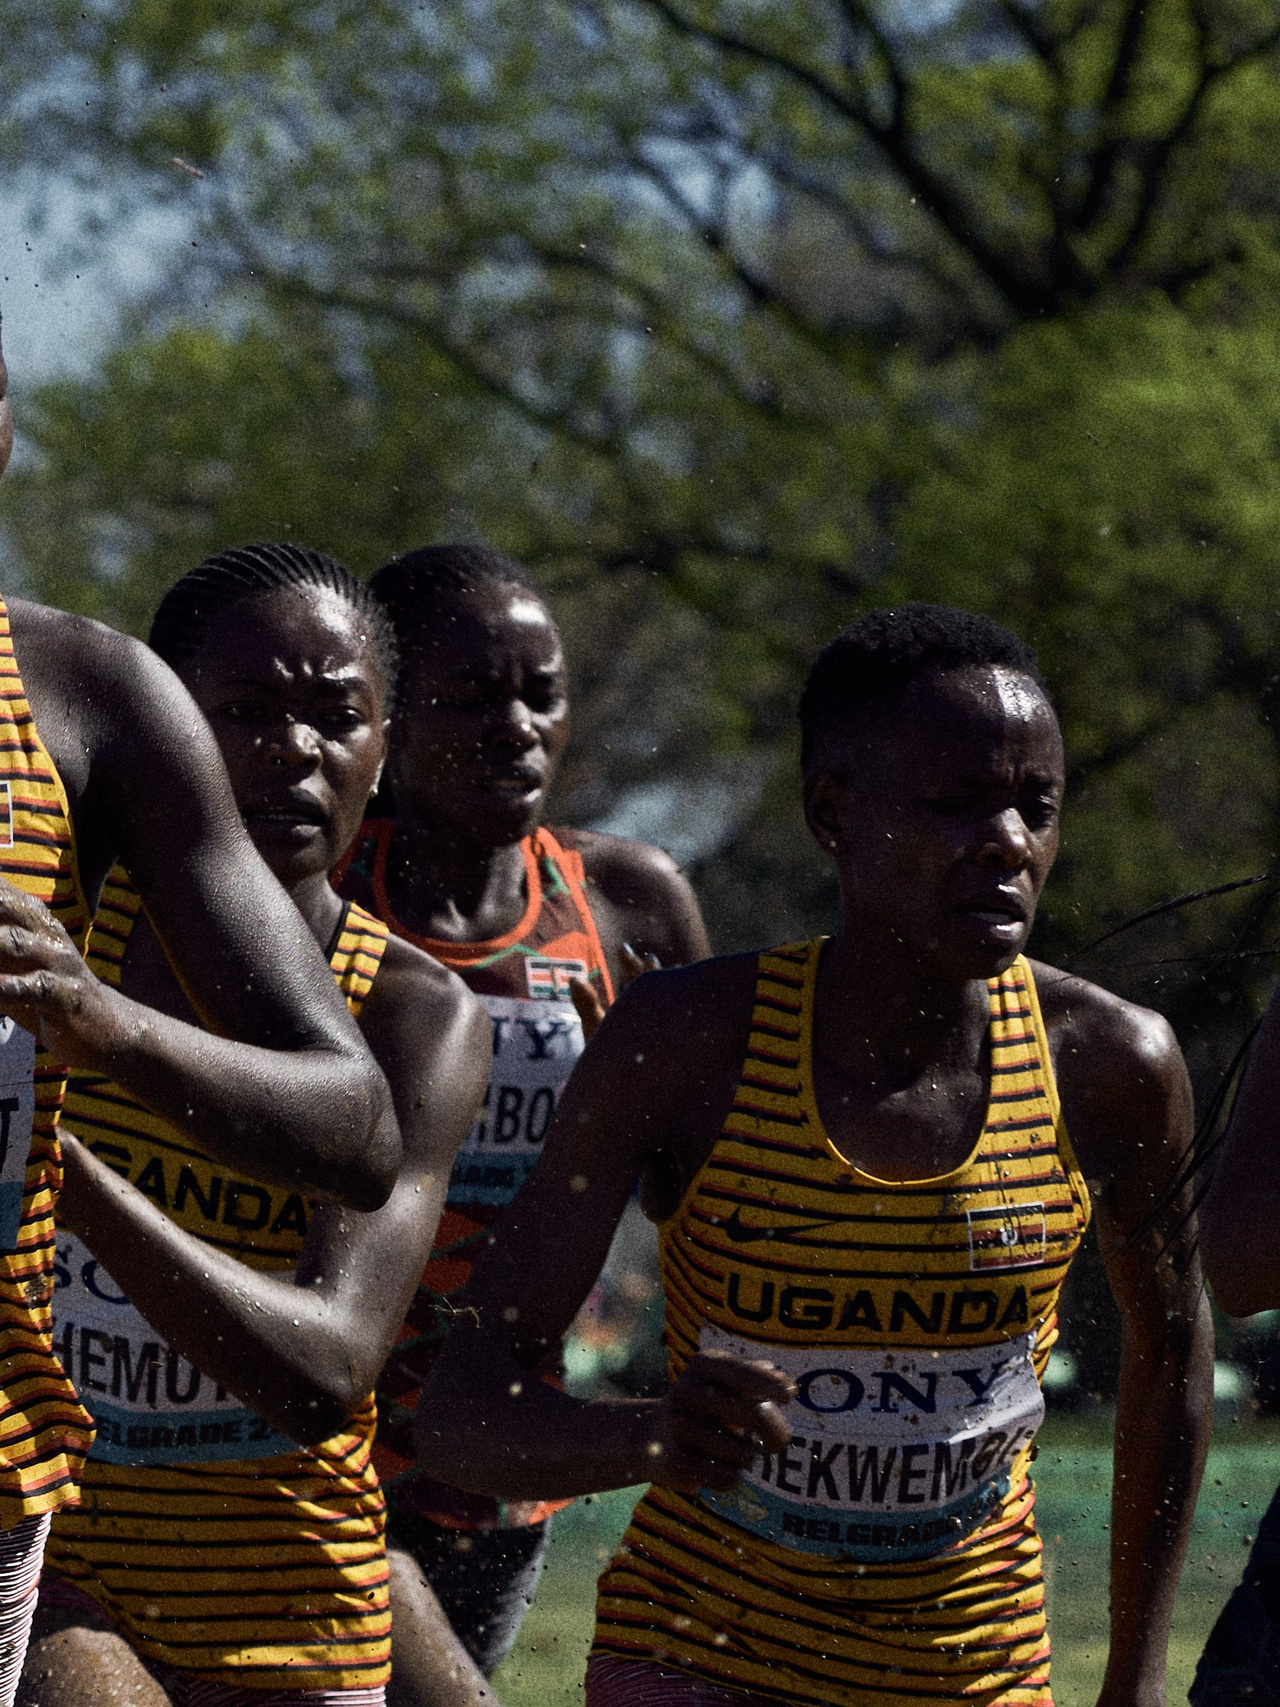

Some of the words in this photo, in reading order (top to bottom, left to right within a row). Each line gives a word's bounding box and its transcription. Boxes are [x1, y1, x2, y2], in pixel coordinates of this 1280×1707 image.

[726, 1271, 1029, 1335] UGANDA
[796, 1359, 1010, 1415] ONY
[95, 1414, 243, 1450] ELGRADE
